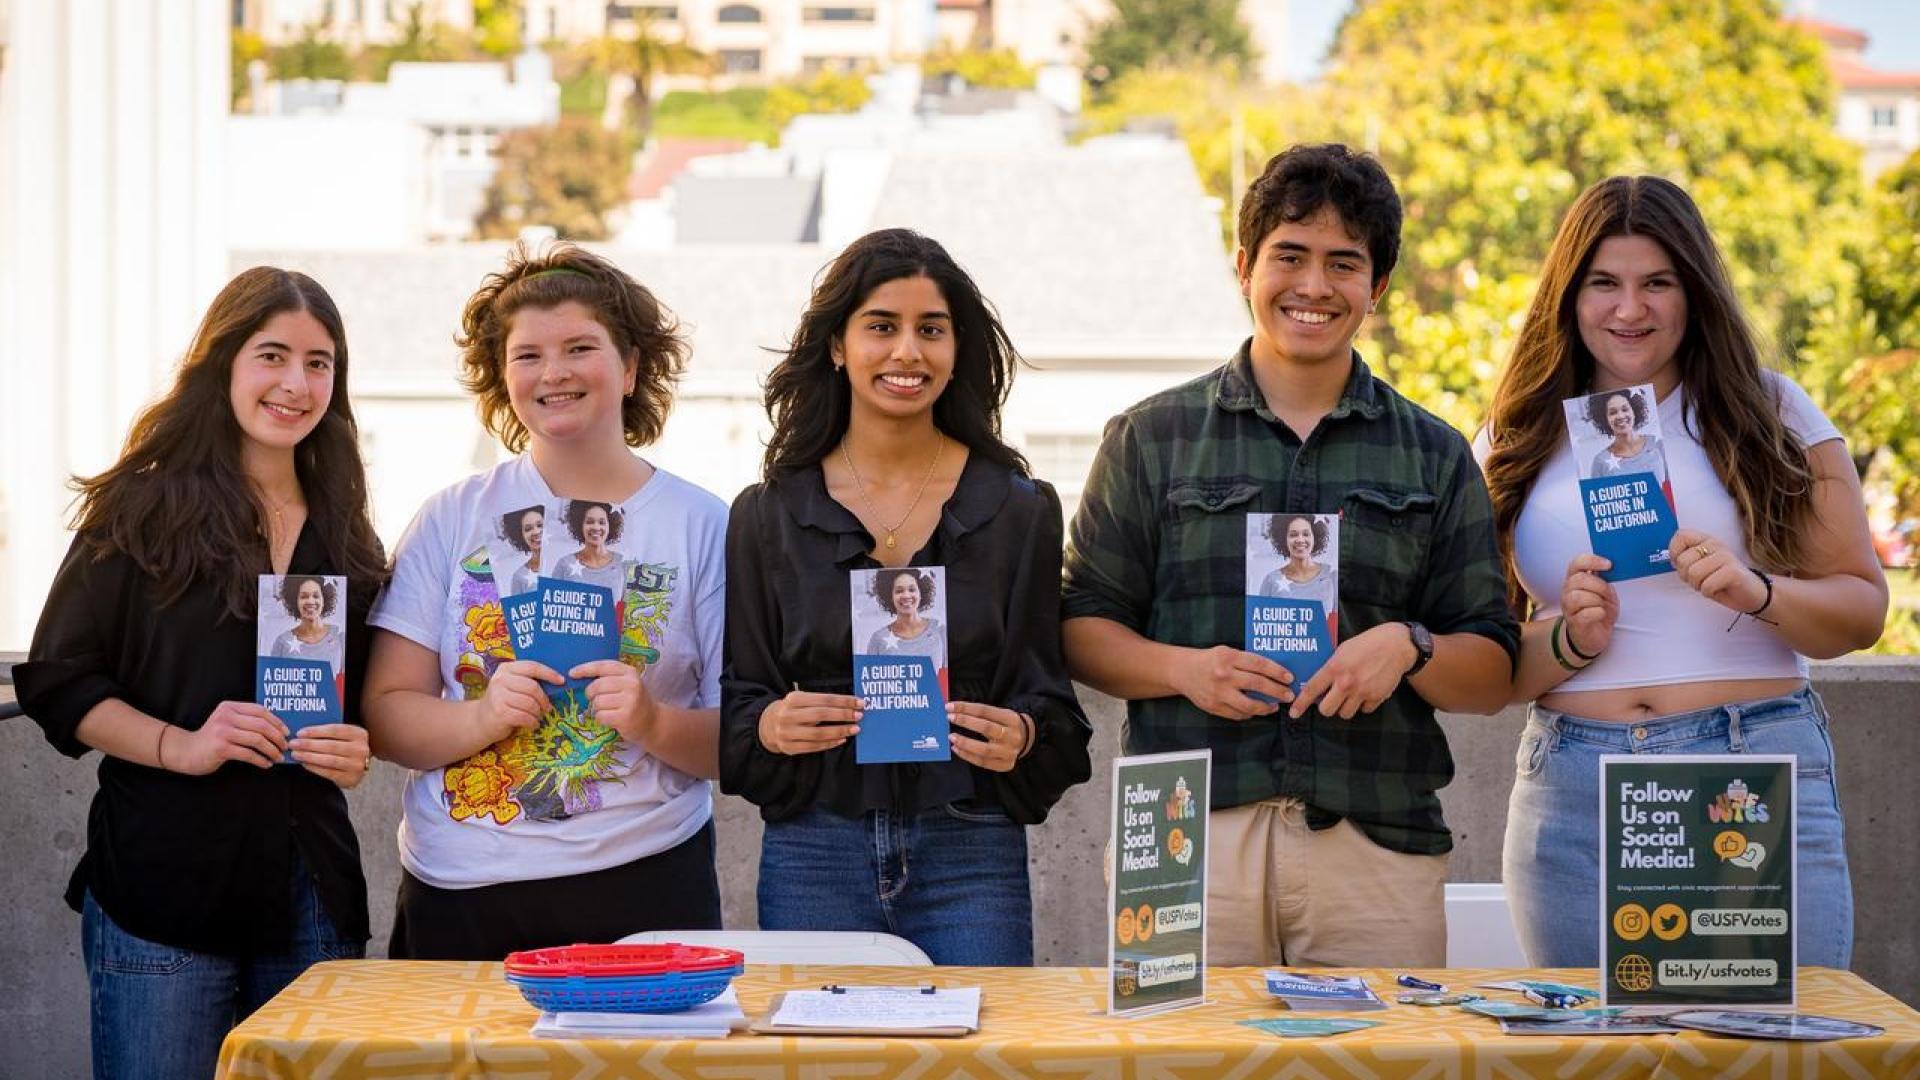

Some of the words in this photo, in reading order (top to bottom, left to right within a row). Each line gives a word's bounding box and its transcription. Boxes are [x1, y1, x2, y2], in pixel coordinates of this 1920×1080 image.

[1589, 489, 1598, 504] A
[1598, 483, 1633, 502] GUIDE
[1632, 480, 1648, 495] TO
[1590, 499, 1631, 518] VOTING
[1632, 496, 1645, 510] IN
[1594, 509, 1659, 533] CALIFORNIA
[542, 588, 551, 603] A
[553, 589, 587, 606] GUIDE
[589, 592, 603, 608] TO
[510, 607, 519, 621] A
[519, 601, 538, 618] GU
[542, 603, 582, 620] VOTING
[584, 607, 597, 621] IN
[1252, 607, 1261, 621] A
[1262, 607, 1297, 621] GUIDE
[1298, 607, 1314, 622] TO
[541, 619, 605, 637] CALIFORNIA
[1252, 622, 1293, 636] VOTING
[1295, 623, 1308, 636] IN
[518, 632, 535, 649] CA
[1253, 637, 1318, 652] CALIFORNIA
[263, 667, 272, 682] A
[274, 668, 307, 682] GUIDE
[308, 668, 322, 682] TO
[861, 666, 870, 680] A
[871, 665, 907, 680] GUIDE
[908, 664, 923, 678] TO
[263, 683, 303, 696] VOTING
[305, 683, 317, 697] IN
[861, 681, 903, 695] VOTING
[905, 679, 918, 693] IN
[263, 698, 327, 712] CALIFORNIA
[863, 695, 929, 711] CALIFORNIA
[1124, 783, 1161, 805] Follow
[1620, 781, 1693, 803] Follow
[1124, 807, 1138, 827] Us
[1139, 811, 1153, 825] on
[1620, 804, 1647, 824] Us
[1651, 809, 1680, 824] on
[1123, 826, 1155, 849] Social
[1621, 826, 1685, 847] Social
[1122, 847, 1159, 872] Media!
[1620, 848, 1696, 869] Media!
[1697, 912, 1782, 928] @USFVotes
[1664, 963, 1772, 981] bit.ly/usfvotes
